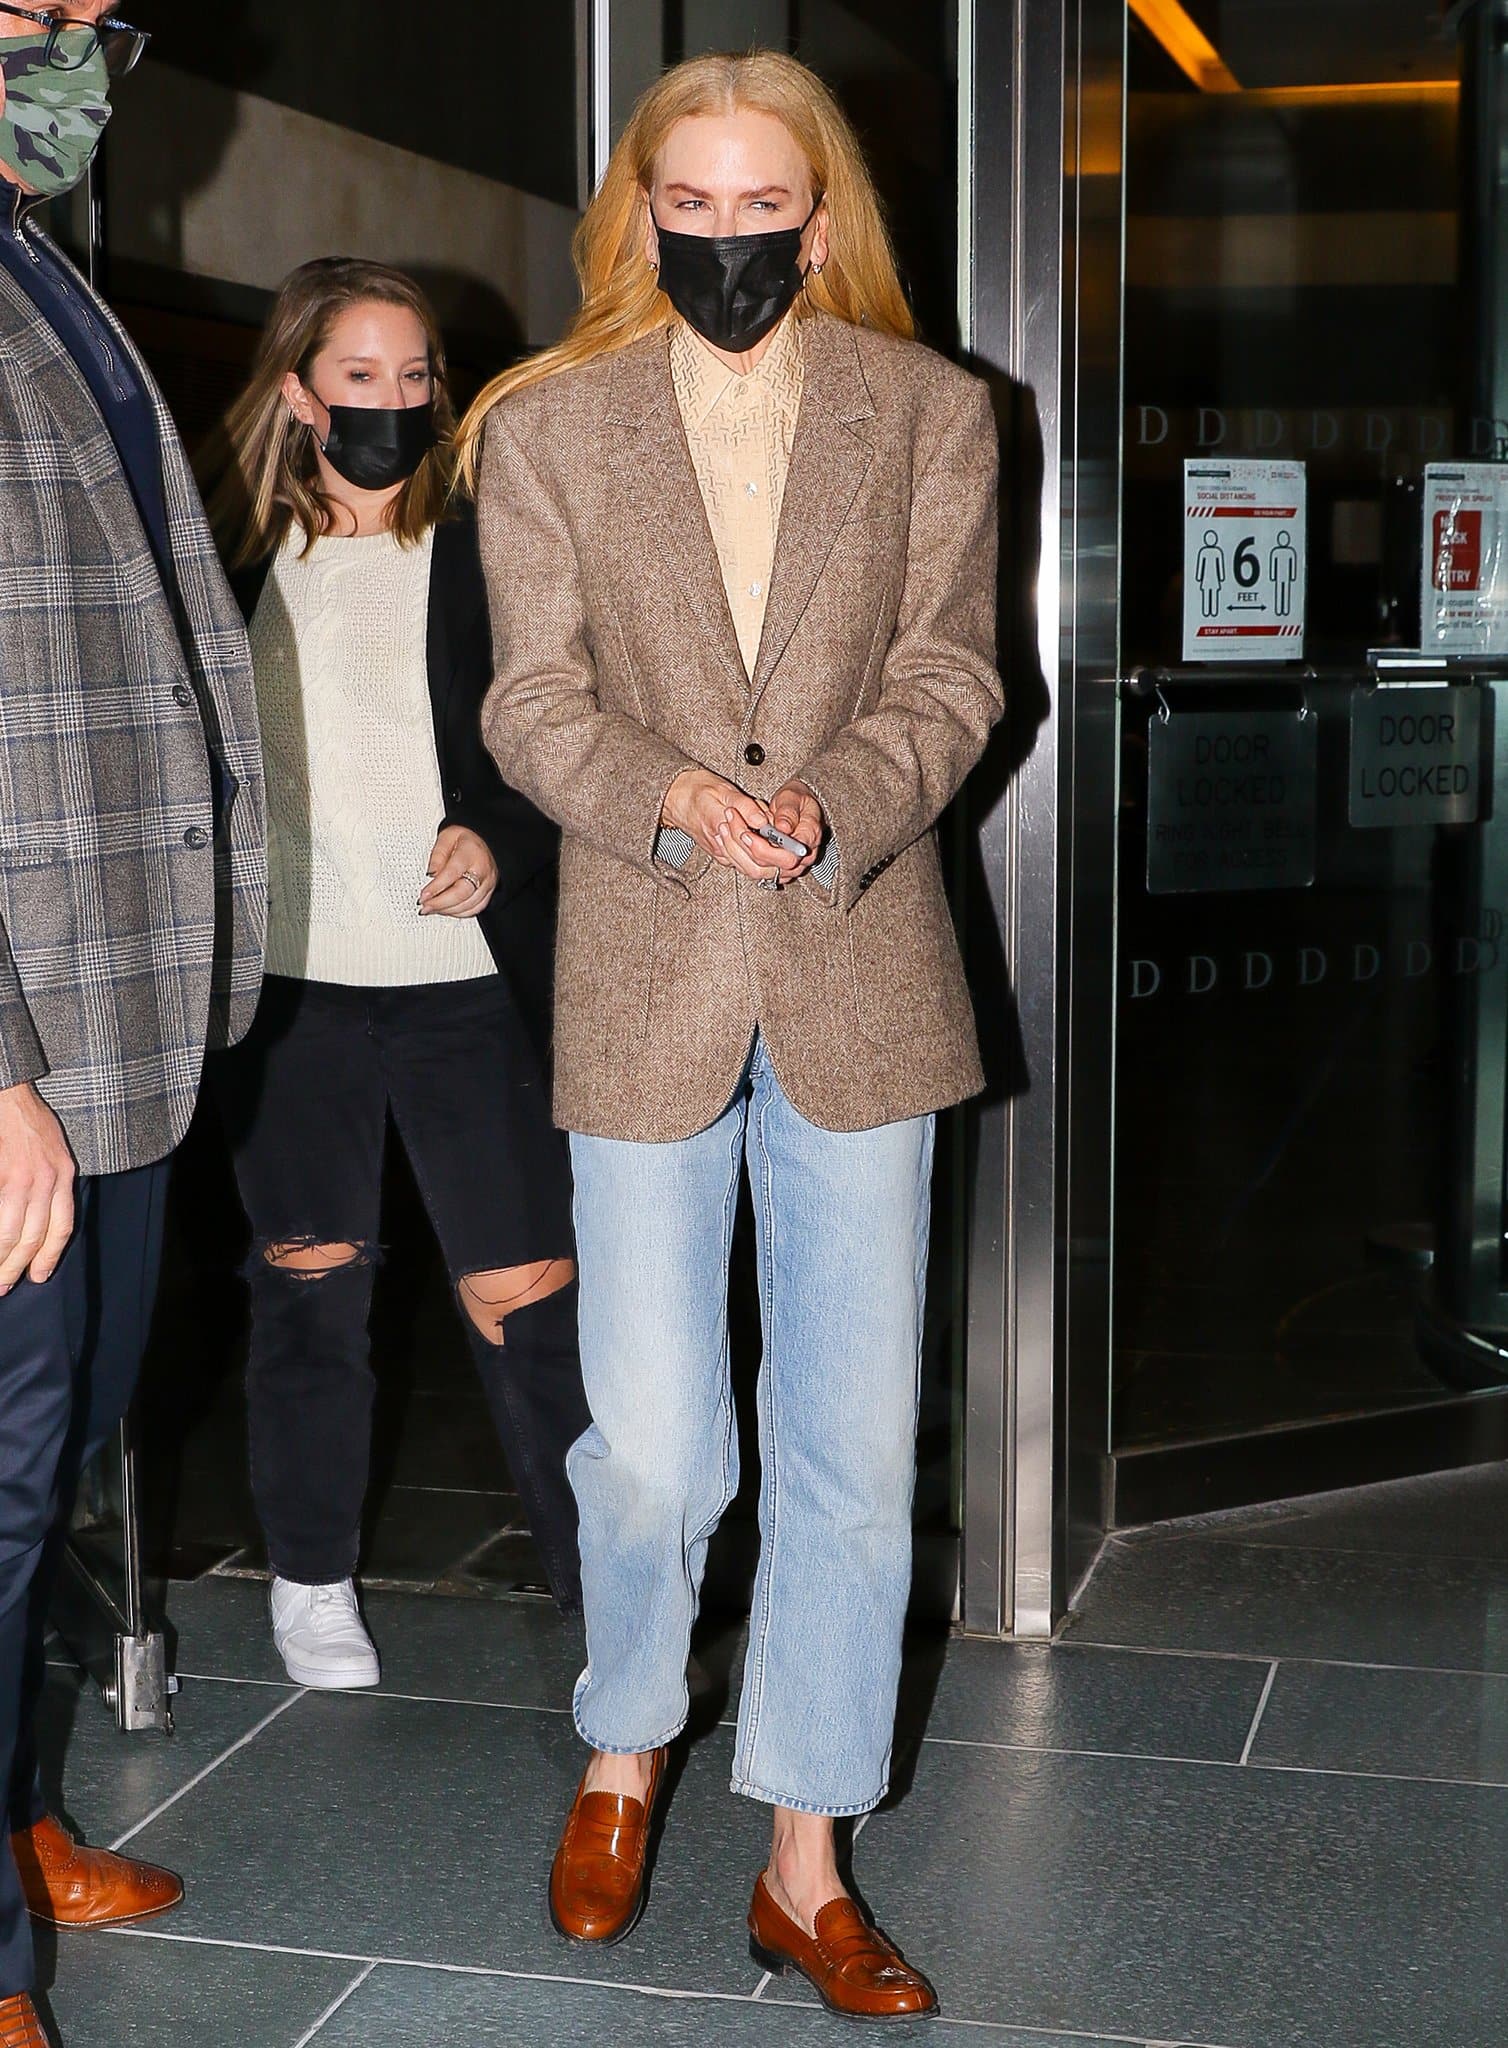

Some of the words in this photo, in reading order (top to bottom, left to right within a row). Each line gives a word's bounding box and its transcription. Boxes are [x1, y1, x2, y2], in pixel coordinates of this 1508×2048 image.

[1136, 405, 1169, 445] D
[1198, 407, 1227, 447] D
[1255, 409, 1284, 449] D
[1311, 410, 1340, 450] D
[1366, 413, 1393, 452] D
[1418, 415, 1445, 453] D
[1219, 492, 1257, 501] DISTANCING
[1233, 536, 1260, 588] 6
[1438, 569, 1472, 583] TRY
[1237, 592, 1259, 602] FEET
[1379, 714, 1455, 746] DOOR
[1195, 733, 1270, 765] DOOR
[1177, 775, 1286, 807] LOCKED
[1361, 764, 1469, 799] LOCKED
[1155, 822, 1193, 841] RING
[1175, 847, 1209, 866] FOR
[1128, 959, 1162, 999] D
[1188, 955, 1218, 994] D
[1244, 950, 1274, 990] D
[1299, 947, 1328, 985] D
[1353, 943, 1381, 981] D
[1406, 940, 1432, 977] D
